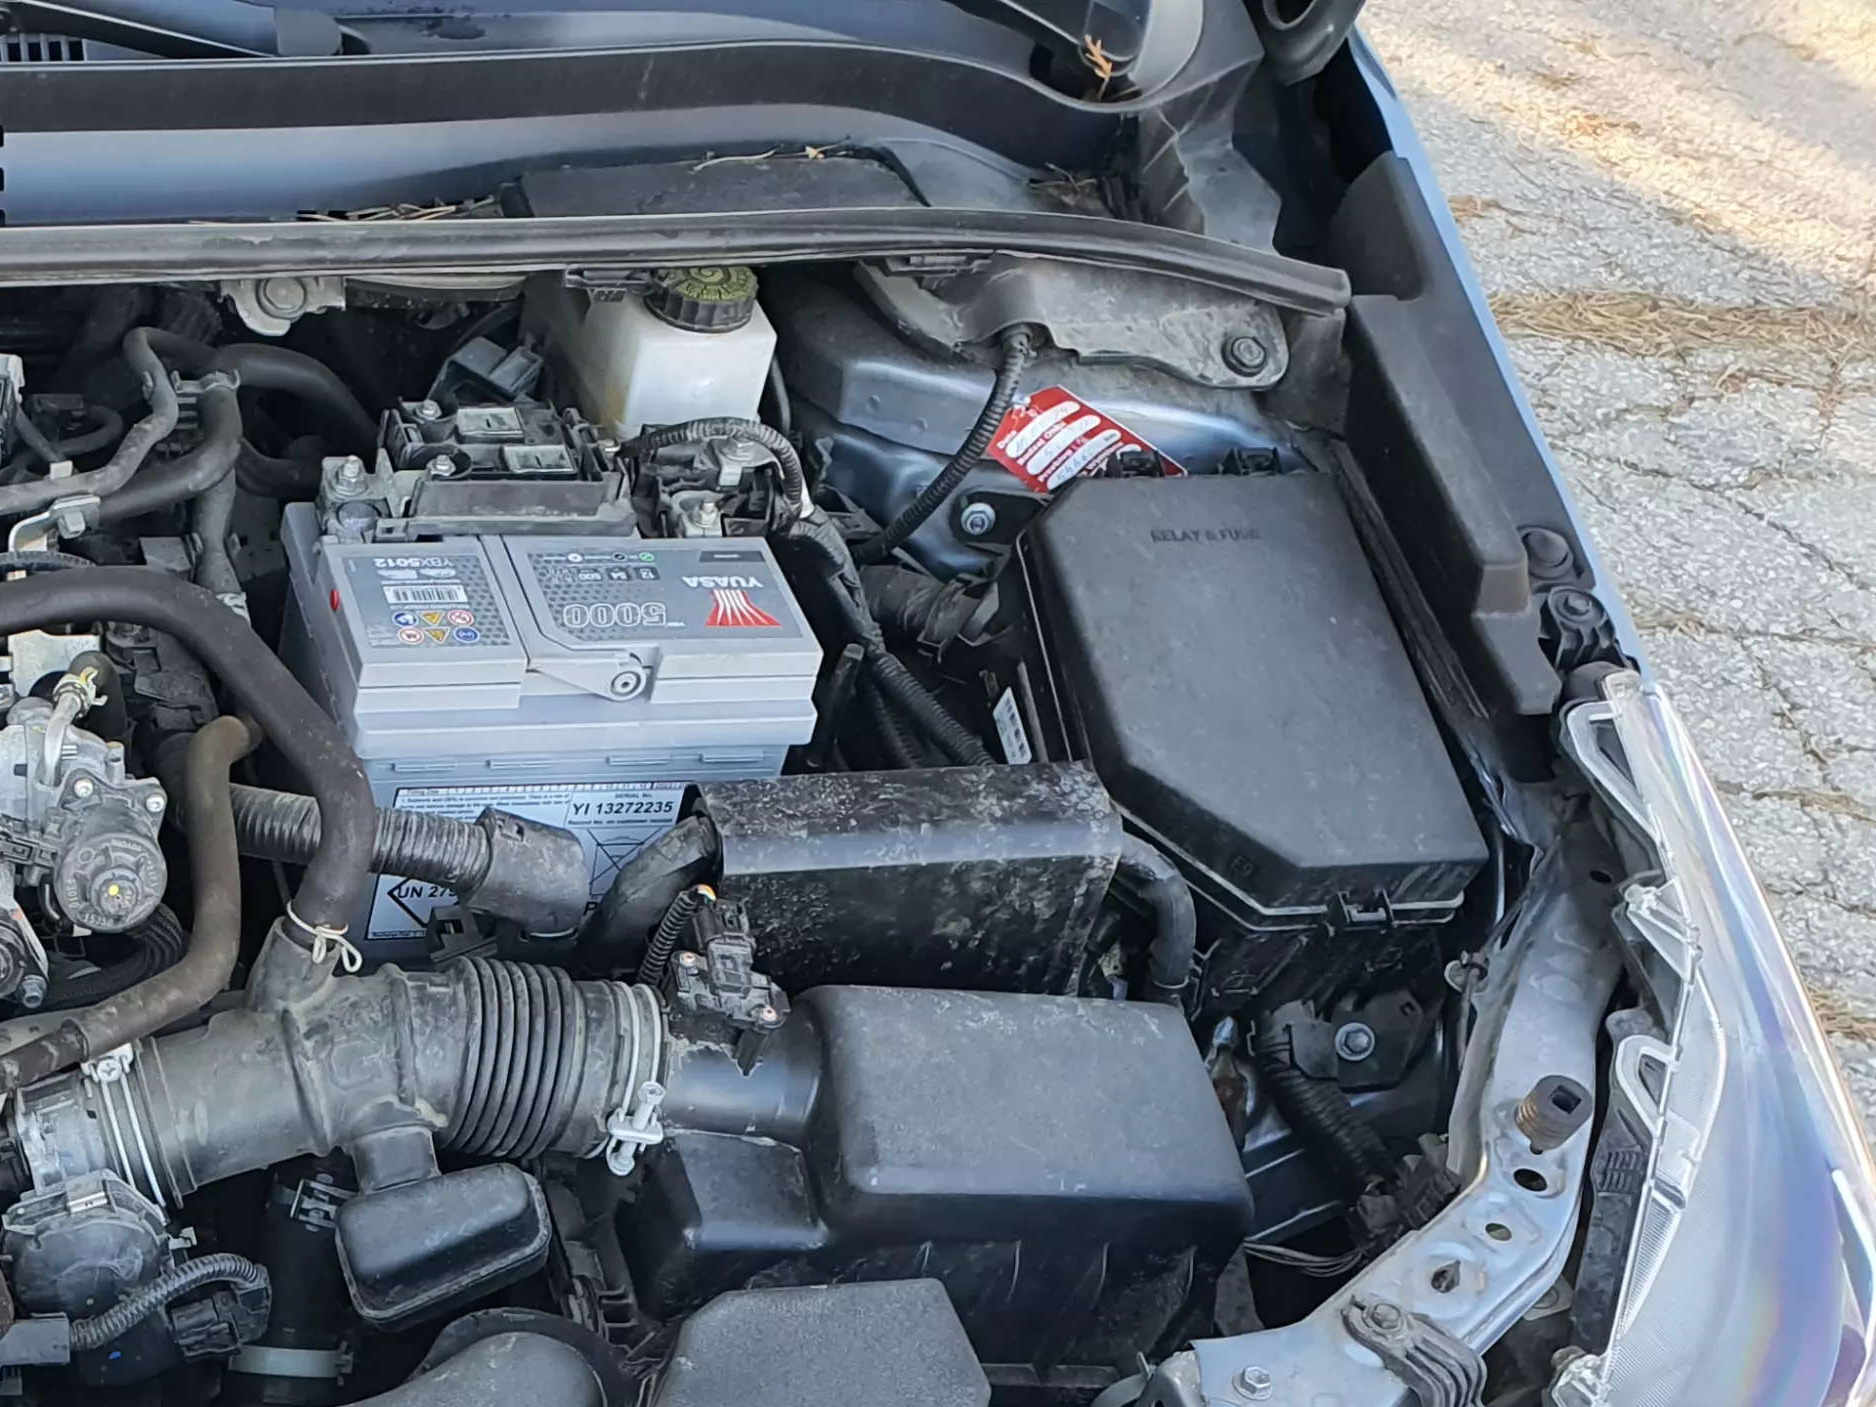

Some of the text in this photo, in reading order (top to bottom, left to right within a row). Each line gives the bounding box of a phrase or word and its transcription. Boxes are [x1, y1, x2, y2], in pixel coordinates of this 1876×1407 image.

[681, 575, 764, 588] YUASA
[562, 602, 667, 629] 5000
[595, 801, 674, 815] 13272235
[397, 885, 424, 899] UN
